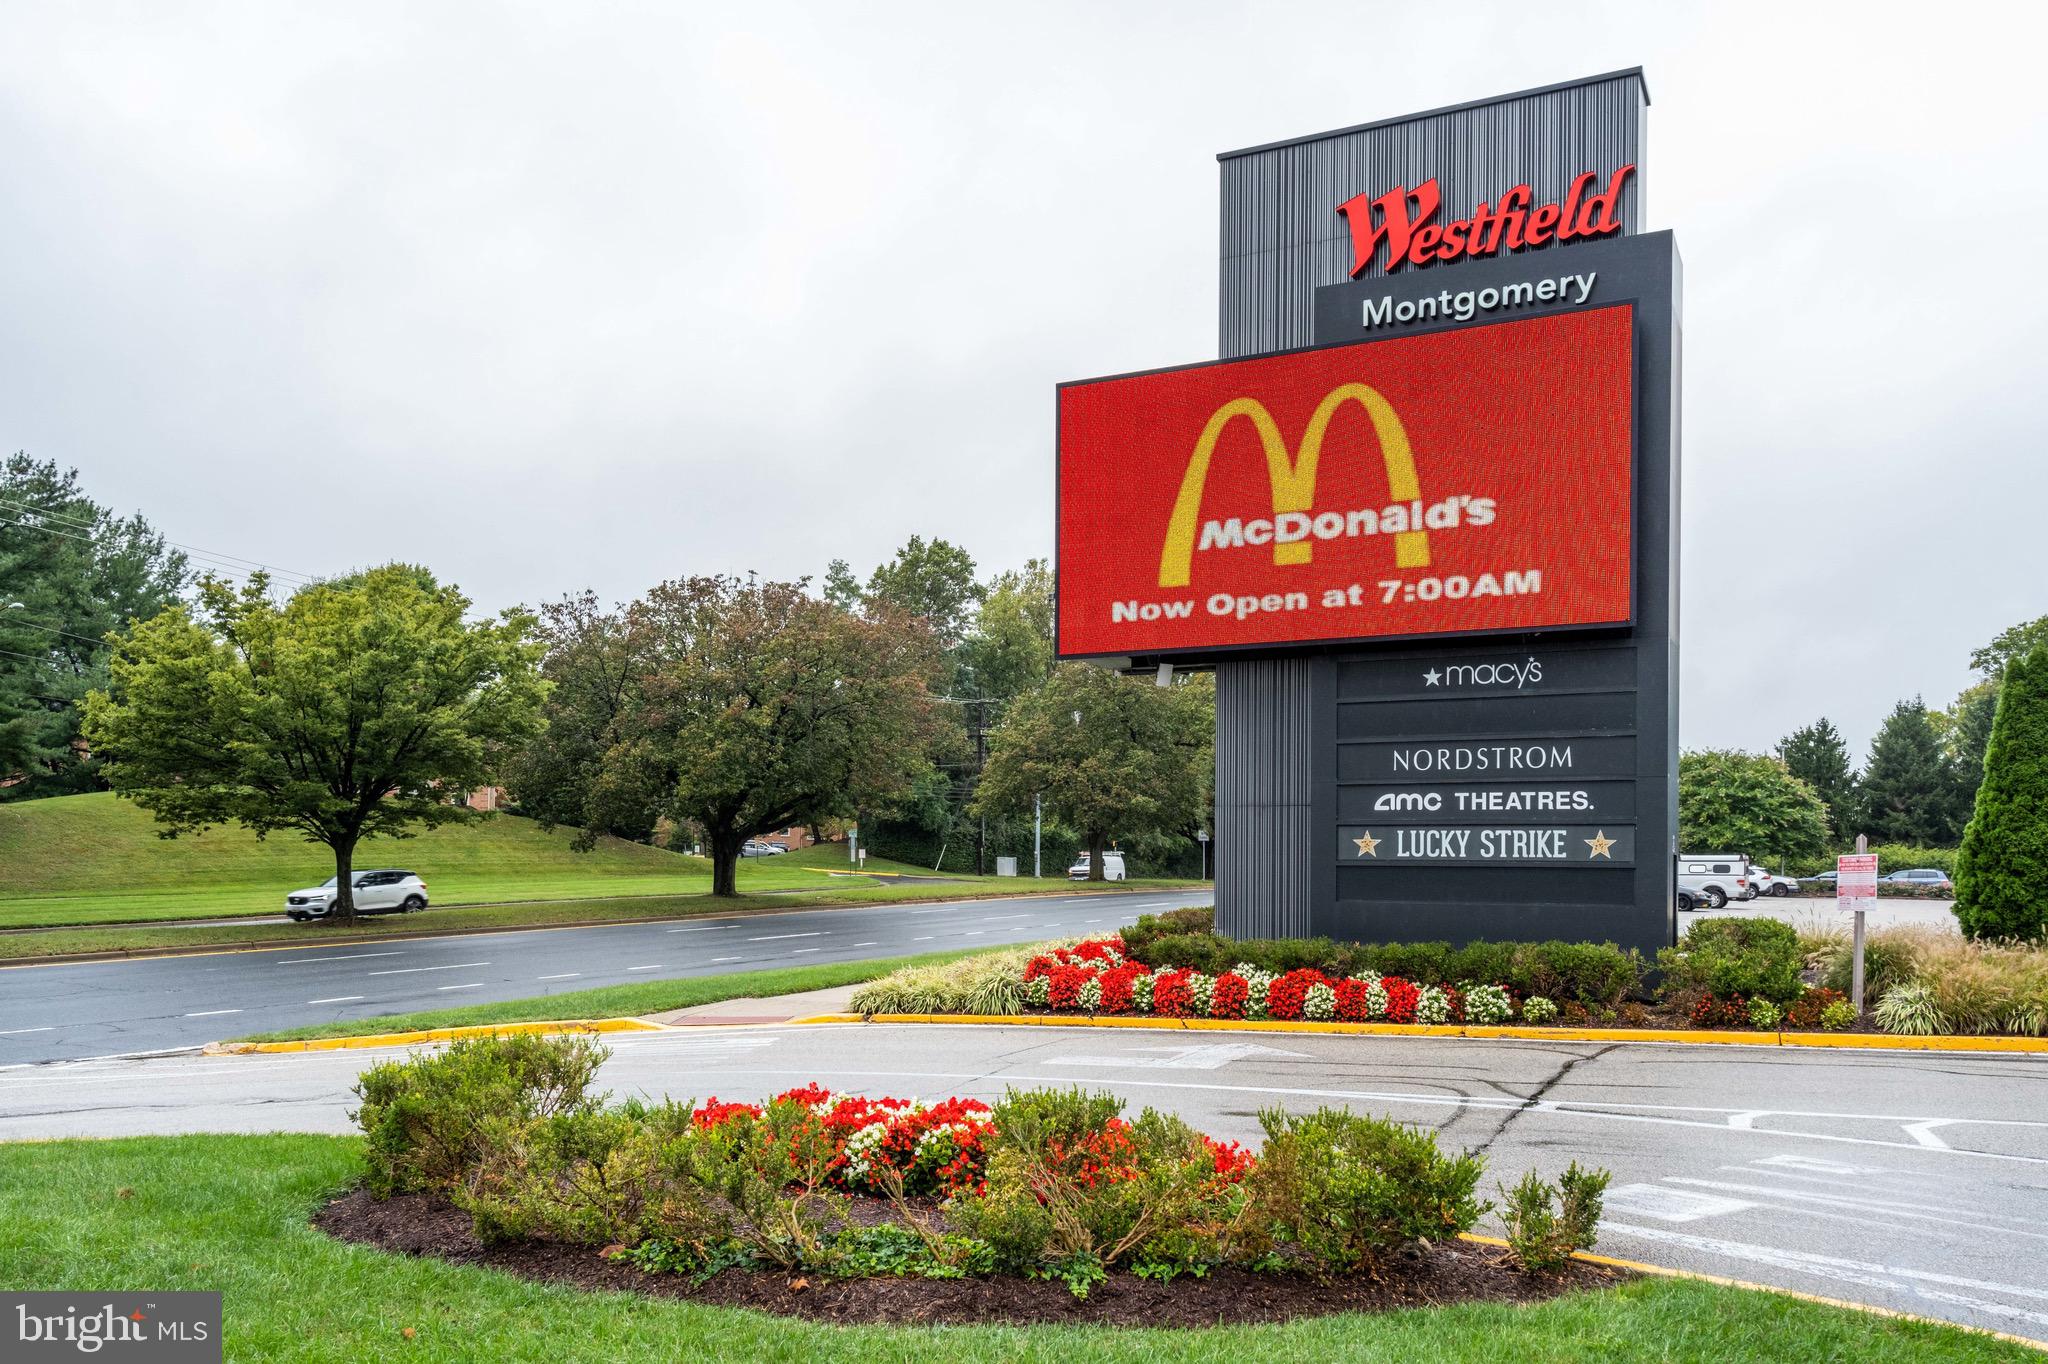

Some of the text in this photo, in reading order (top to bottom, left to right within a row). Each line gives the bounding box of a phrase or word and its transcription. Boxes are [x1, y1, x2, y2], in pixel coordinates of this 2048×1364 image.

[1336, 165, 1635, 277] Westfield
[1361, 272, 1597, 327] Montgomery
[1199, 496, 1496, 550] McDonald's
[1112, 571, 1541, 624] Now Open at 7:00AM
[1393, 746, 1572, 771] NORDSTROM
[1397, 830, 1567, 858] LUCKY STRIKE
